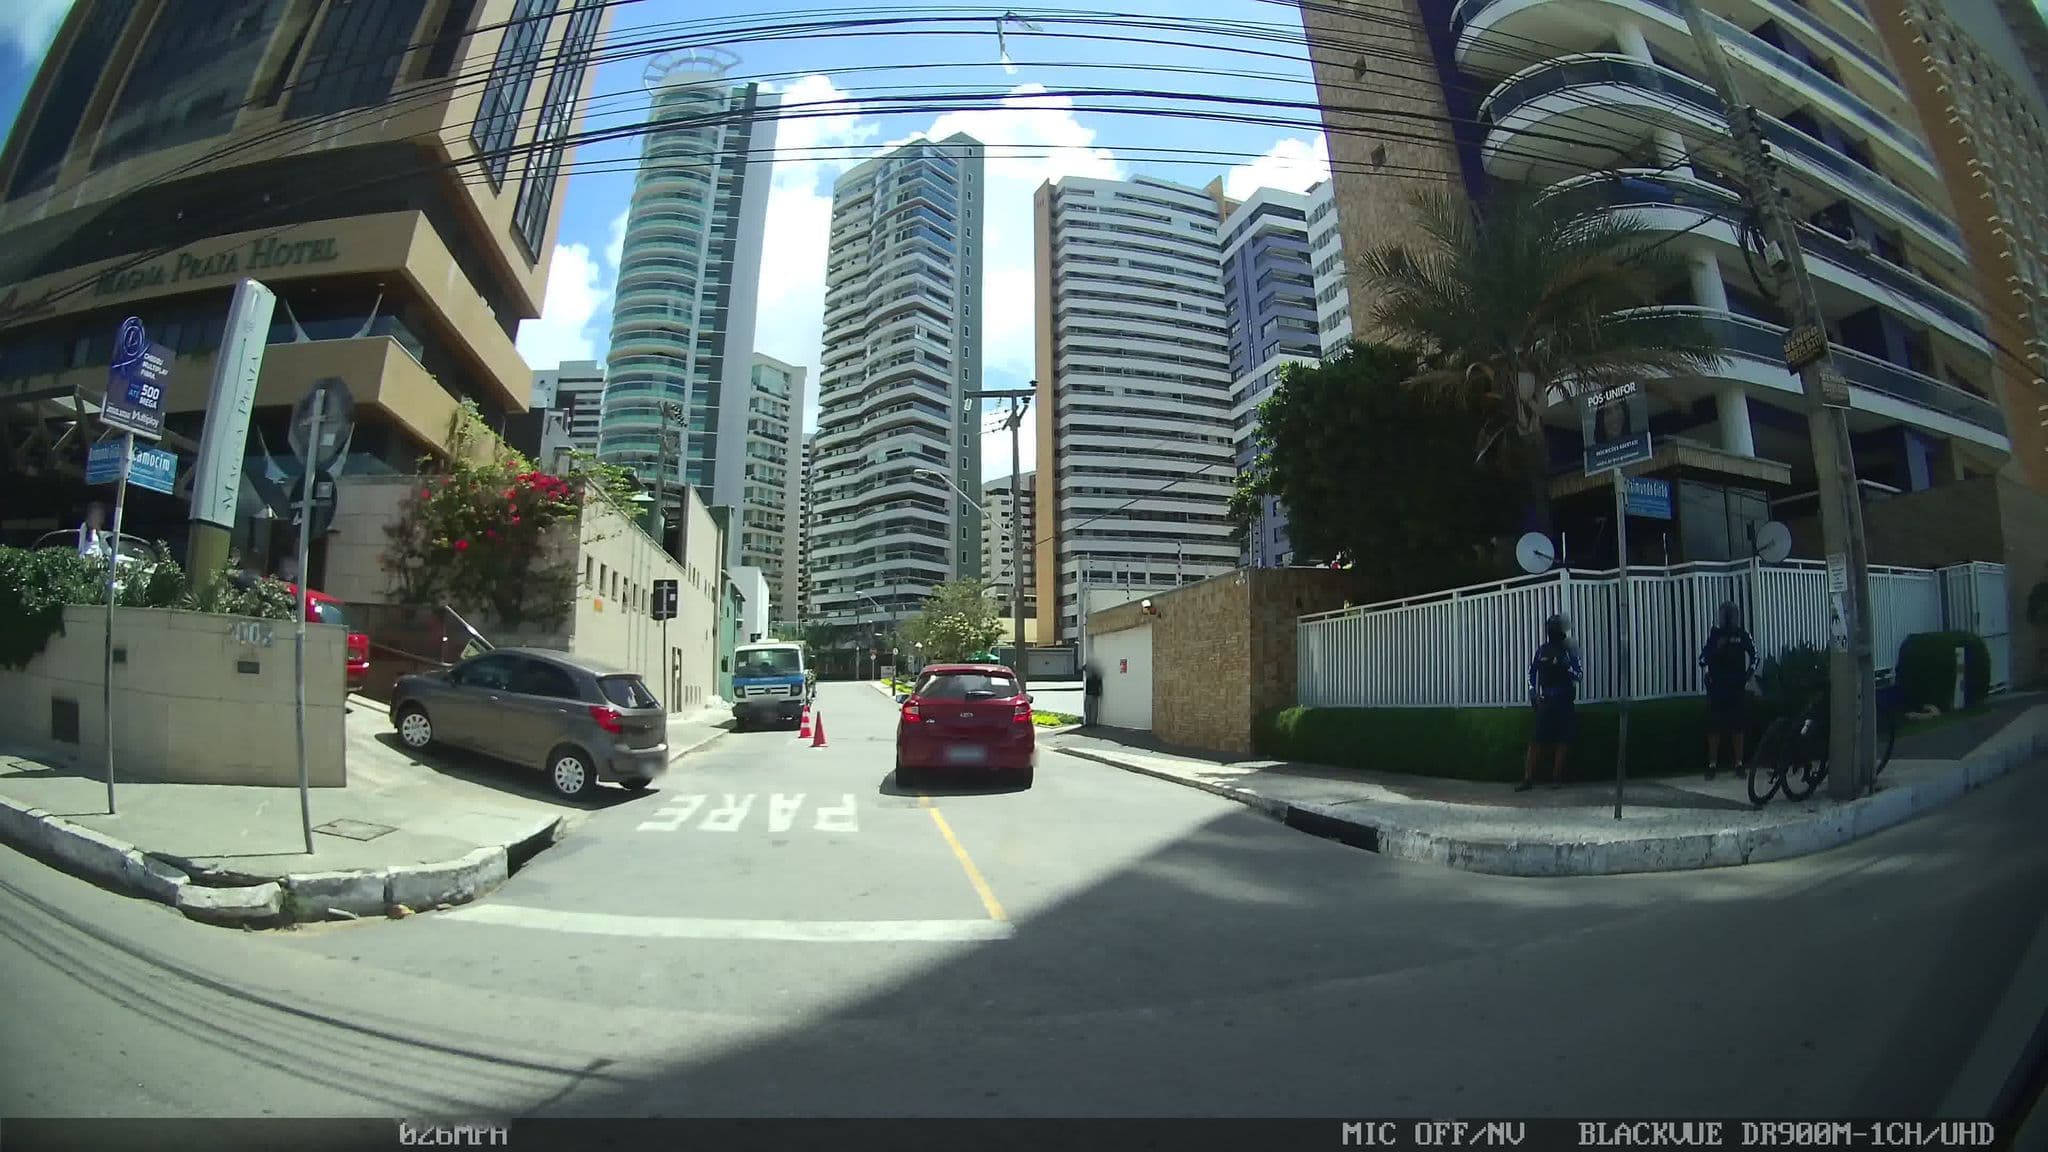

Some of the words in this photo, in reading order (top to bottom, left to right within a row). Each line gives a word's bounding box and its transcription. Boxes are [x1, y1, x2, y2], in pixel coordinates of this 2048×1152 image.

[171, 250, 238, 283] PRAIA
[247, 237, 339, 270] HOTEL
[140, 384, 160, 400] 500
[132, 446, 171, 472] Camocim
[635, 793, 859, 832] PARE
